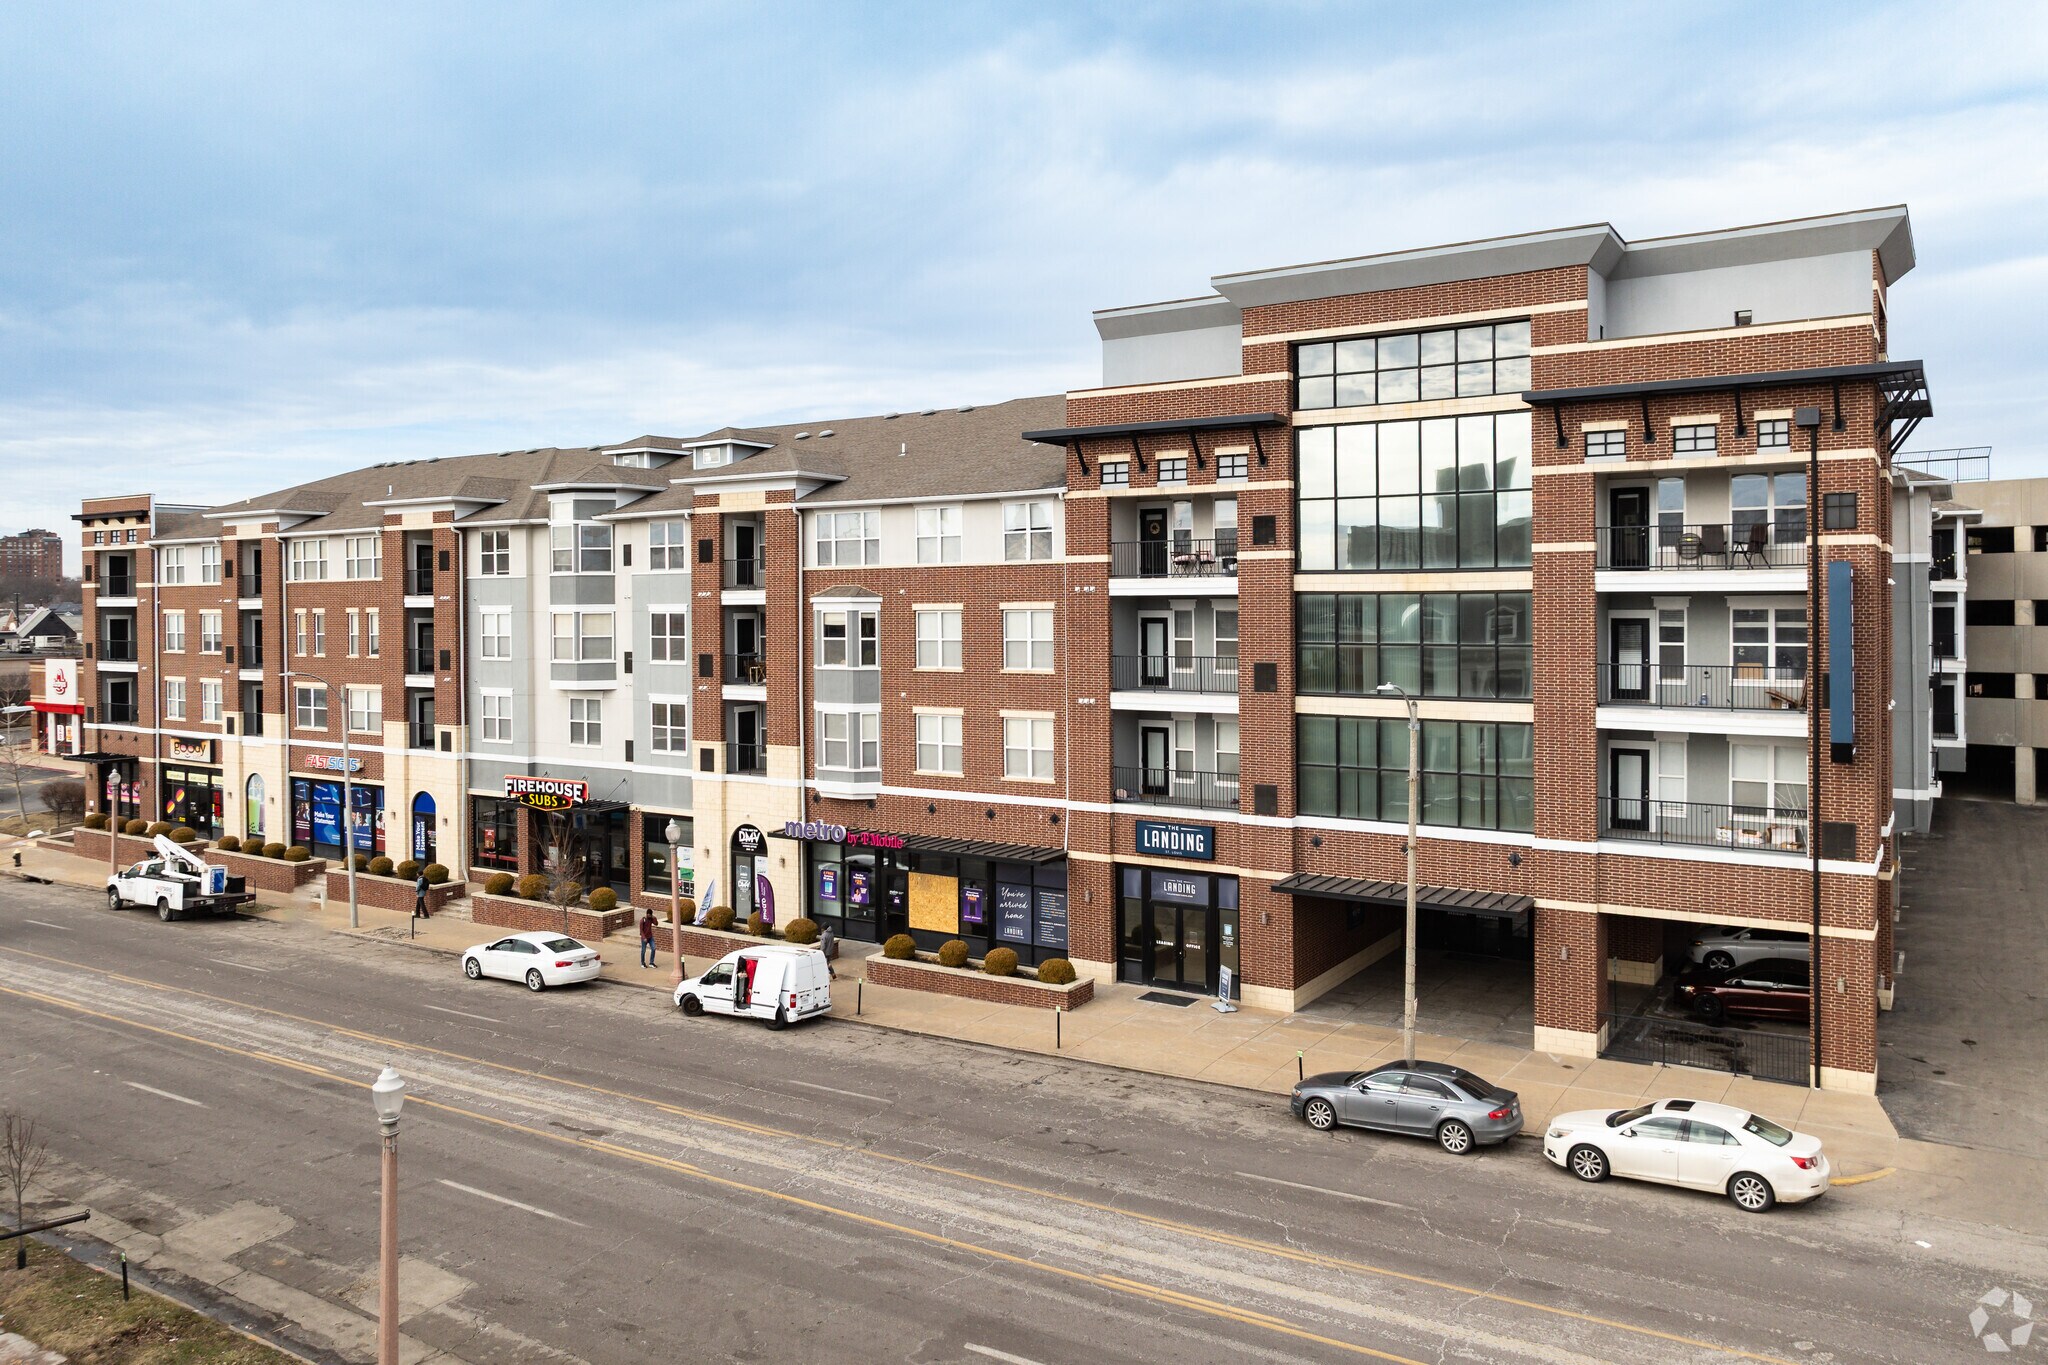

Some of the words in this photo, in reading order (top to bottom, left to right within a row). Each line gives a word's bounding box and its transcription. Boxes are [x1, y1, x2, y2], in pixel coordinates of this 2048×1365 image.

[305, 754, 359, 771] FASTSIGS
[504, 778, 583, 804] FIREHOUSE
[529, 793, 558, 807] SUBS
[738, 830, 761, 844] DMV
[784, 819, 845, 843] metro
[847, 832, 859, 847] by
[1144, 829, 1204, 853] LANDING
[1001, 886, 1026, 900] You're
[1163, 881, 1196, 895] LANDING
[999, 901, 1028, 909] arrived
[1004, 911, 1025, 919] home
